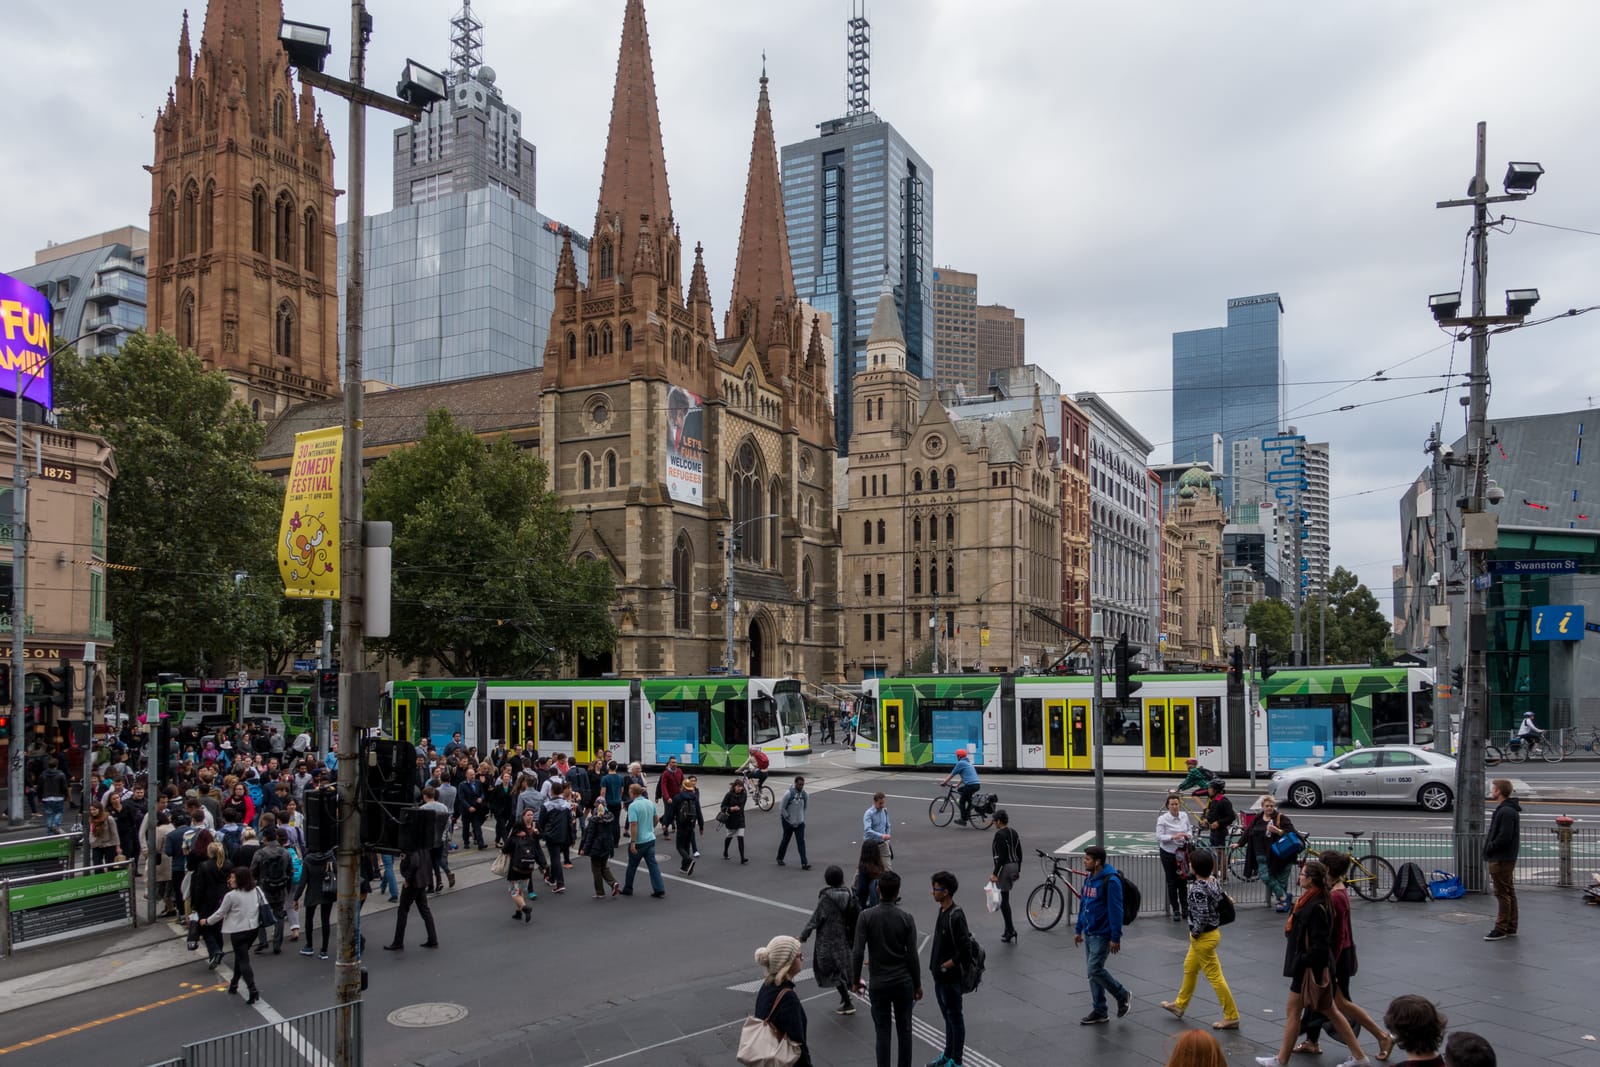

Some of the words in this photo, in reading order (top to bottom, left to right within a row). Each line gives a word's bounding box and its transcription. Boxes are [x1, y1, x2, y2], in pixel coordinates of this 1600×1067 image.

[0, 299, 50, 354] FUN
[683, 436, 702, 449] LET'S
[298, 445, 309, 459] 30
[681, 447, 702, 461] FULLY
[294, 456, 335, 477] COMEDY
[670, 455, 702, 473] WELCOME
[44, 466, 72, 480] 1875
[668, 467, 702, 484] REFUGEES
[291, 475, 333, 494] FESTIVAL
[1514, 561, 1562, 570] Swanston
[1564, 560, 1575, 569] St
